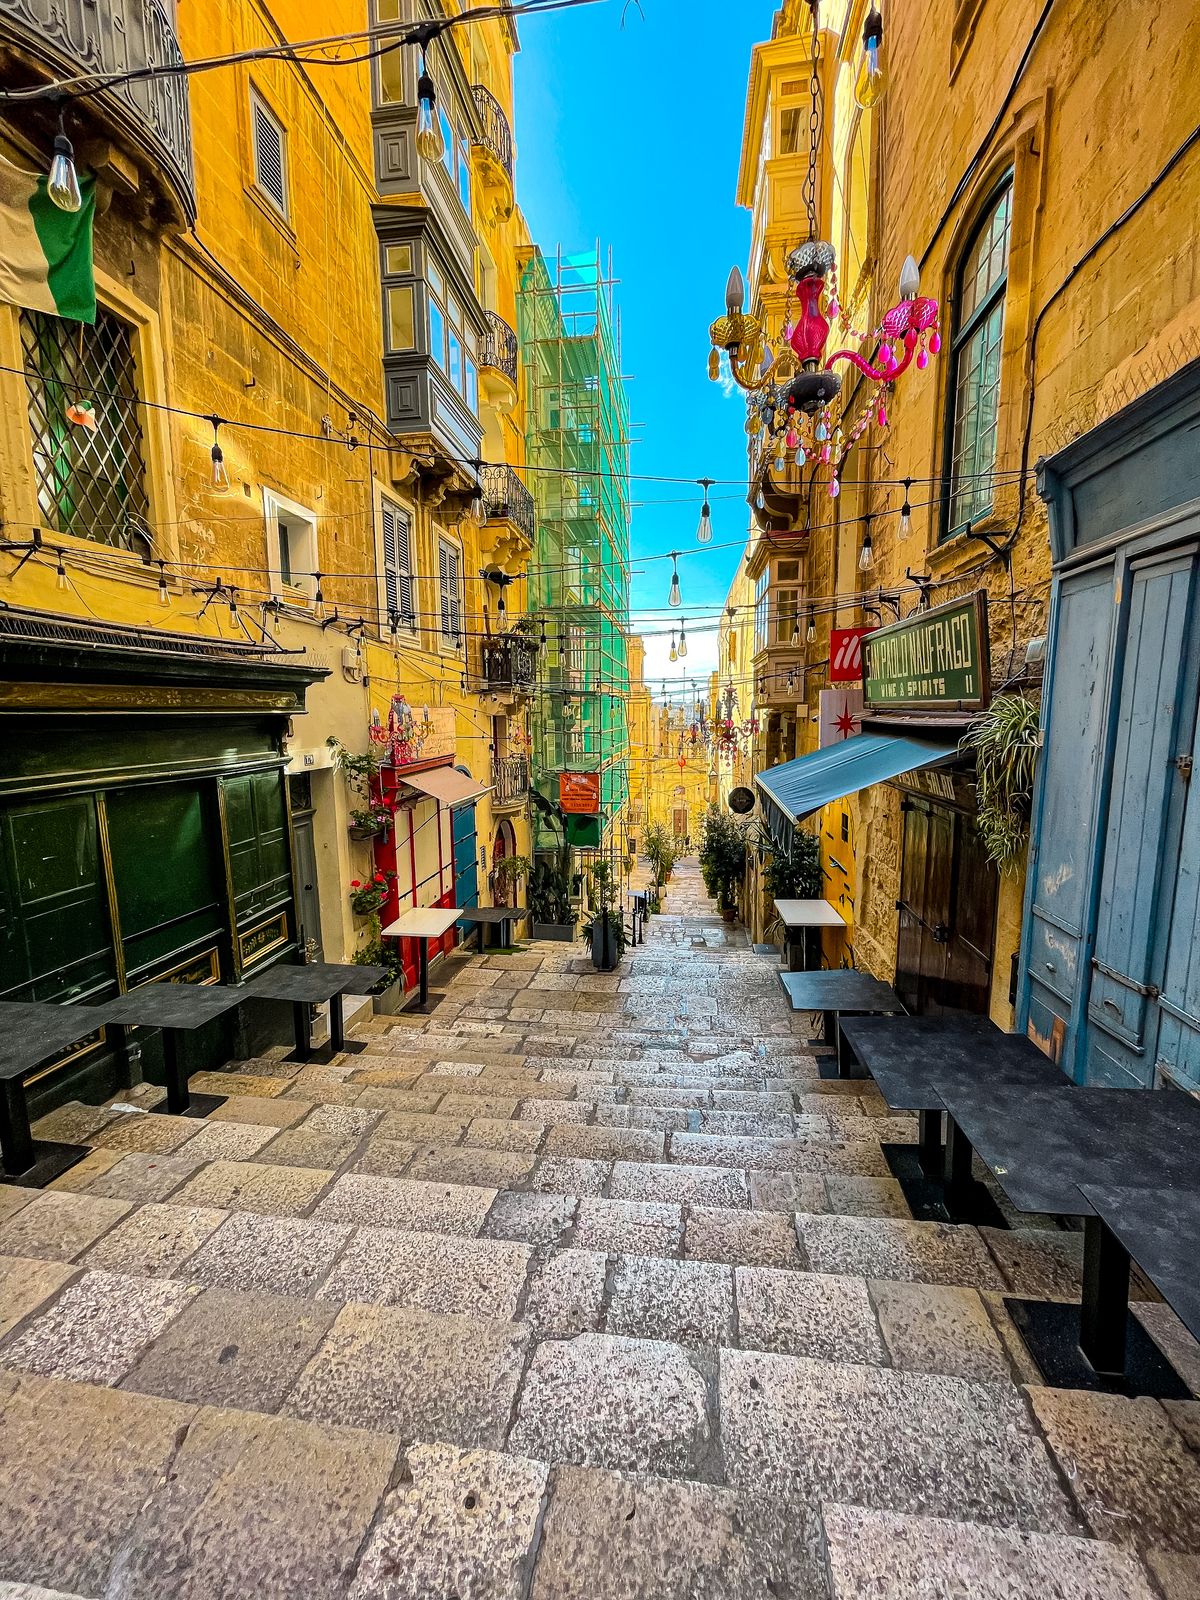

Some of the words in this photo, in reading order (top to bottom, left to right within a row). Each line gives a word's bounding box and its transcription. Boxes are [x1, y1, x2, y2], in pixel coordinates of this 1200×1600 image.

[865, 643, 880, 681] SAN
[880, 634, 909, 680] PAOLO
[909, 613, 972, 677] NAUFRAGO
[880, 682, 897, 698] WINE
[899, 681, 905, 697] &
[907, 677, 946, 697] SPIRITS
